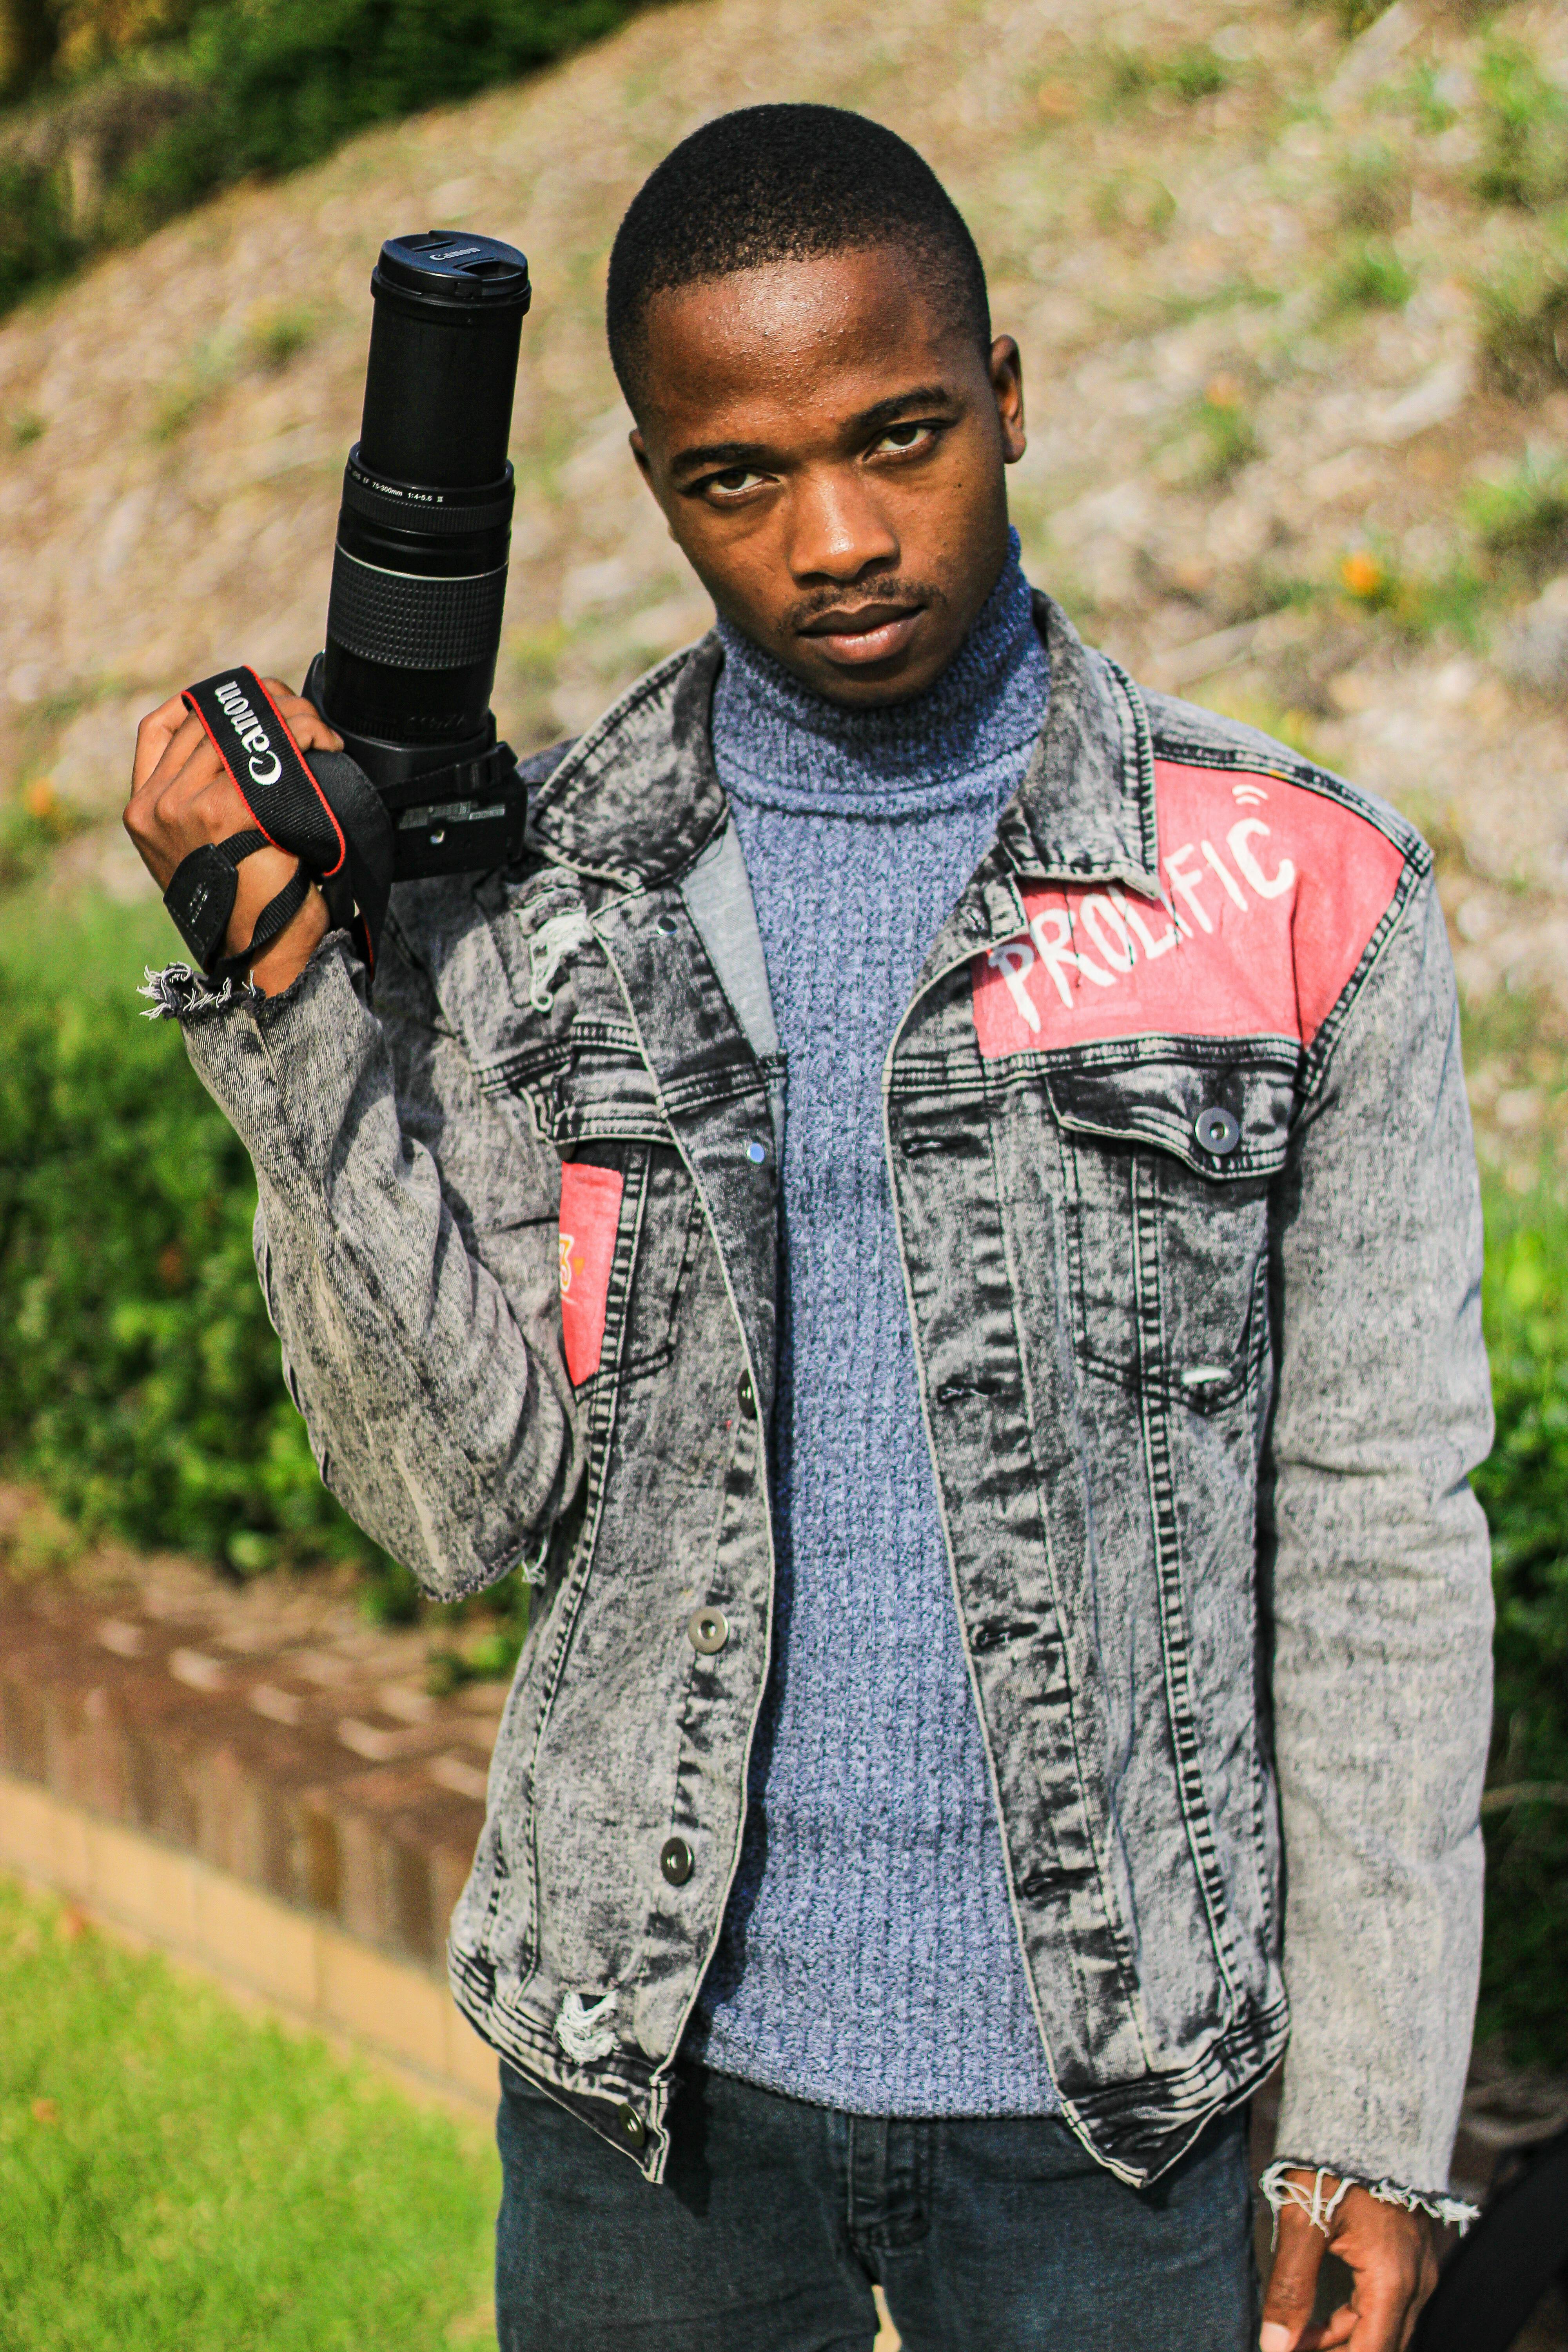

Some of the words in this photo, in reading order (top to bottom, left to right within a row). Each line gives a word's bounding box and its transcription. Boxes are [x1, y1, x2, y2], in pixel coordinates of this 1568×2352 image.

[429, 248, 481, 260] Canon
[372, 482, 403, 496] 75-300mm
[214, 681, 282, 786] Canon
[989, 818, 1295, 1034] PROLIFIC
